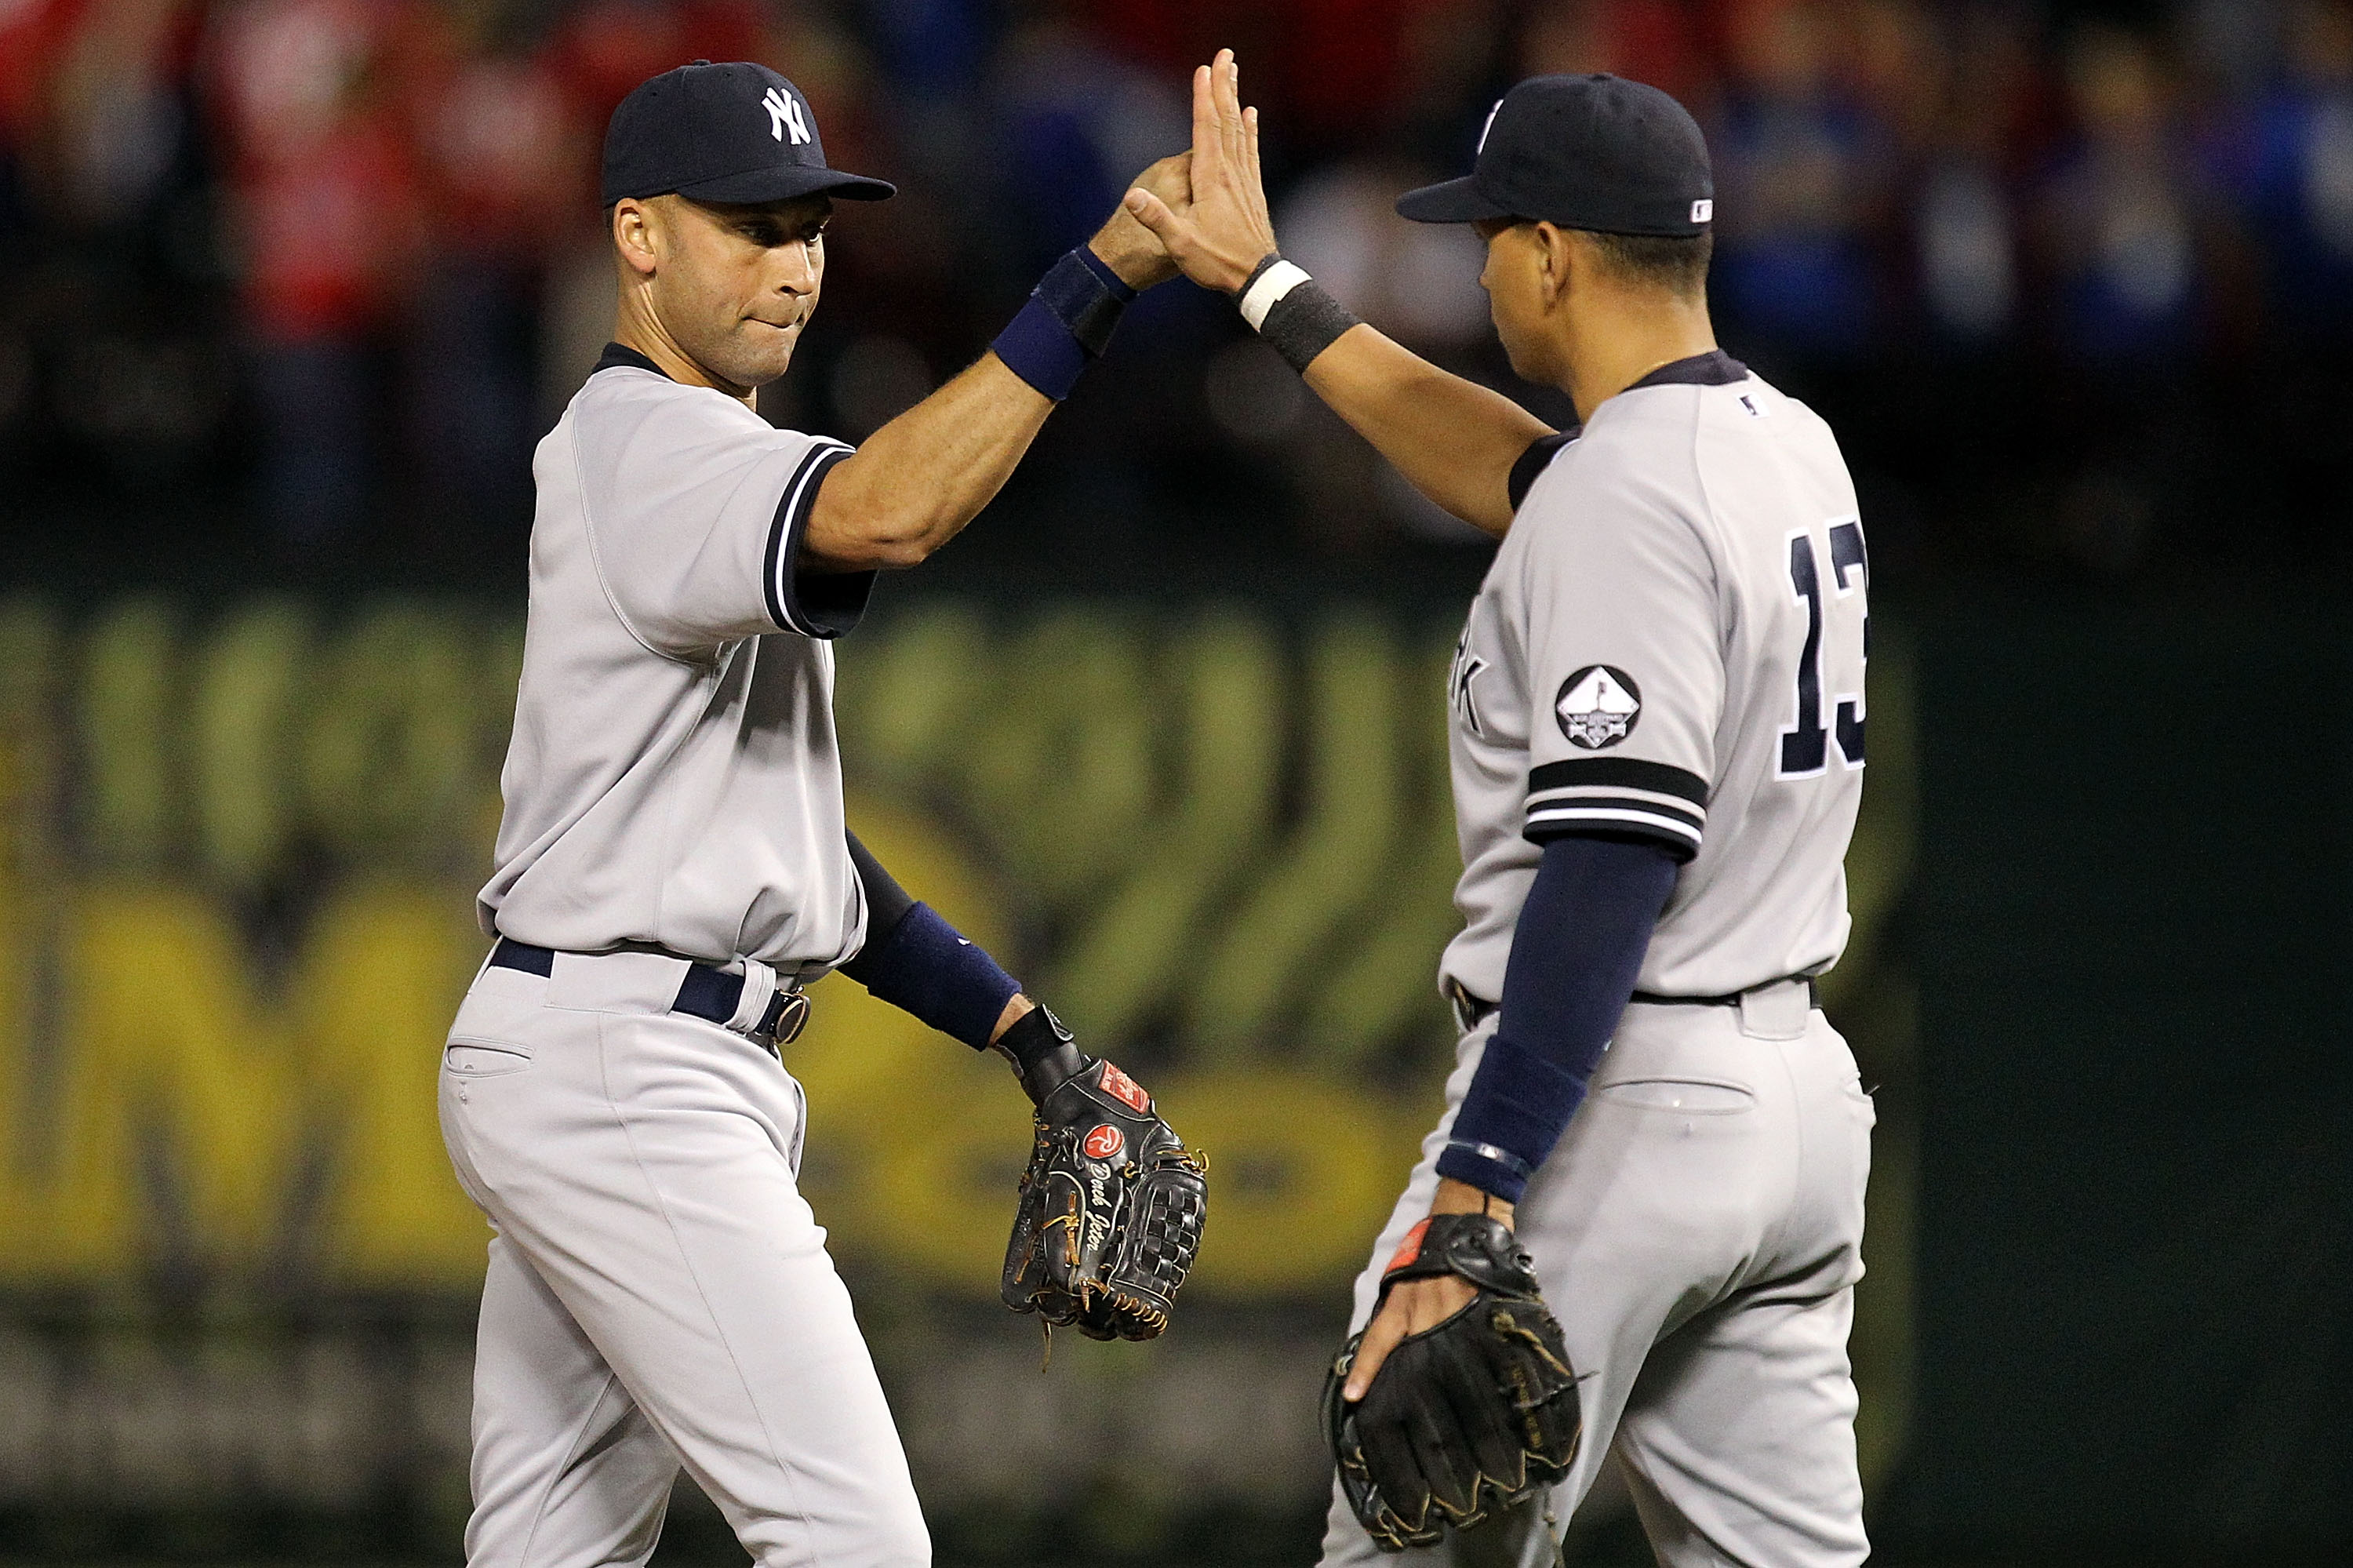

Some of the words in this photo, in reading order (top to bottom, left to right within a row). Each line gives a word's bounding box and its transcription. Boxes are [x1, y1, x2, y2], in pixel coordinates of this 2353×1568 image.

[761, 87, 812, 145] NY
[1774, 515, 1869, 782] 13
[1089, 1162, 1112, 1208] Derek
[1086, 1210, 1111, 1251] Jeter
